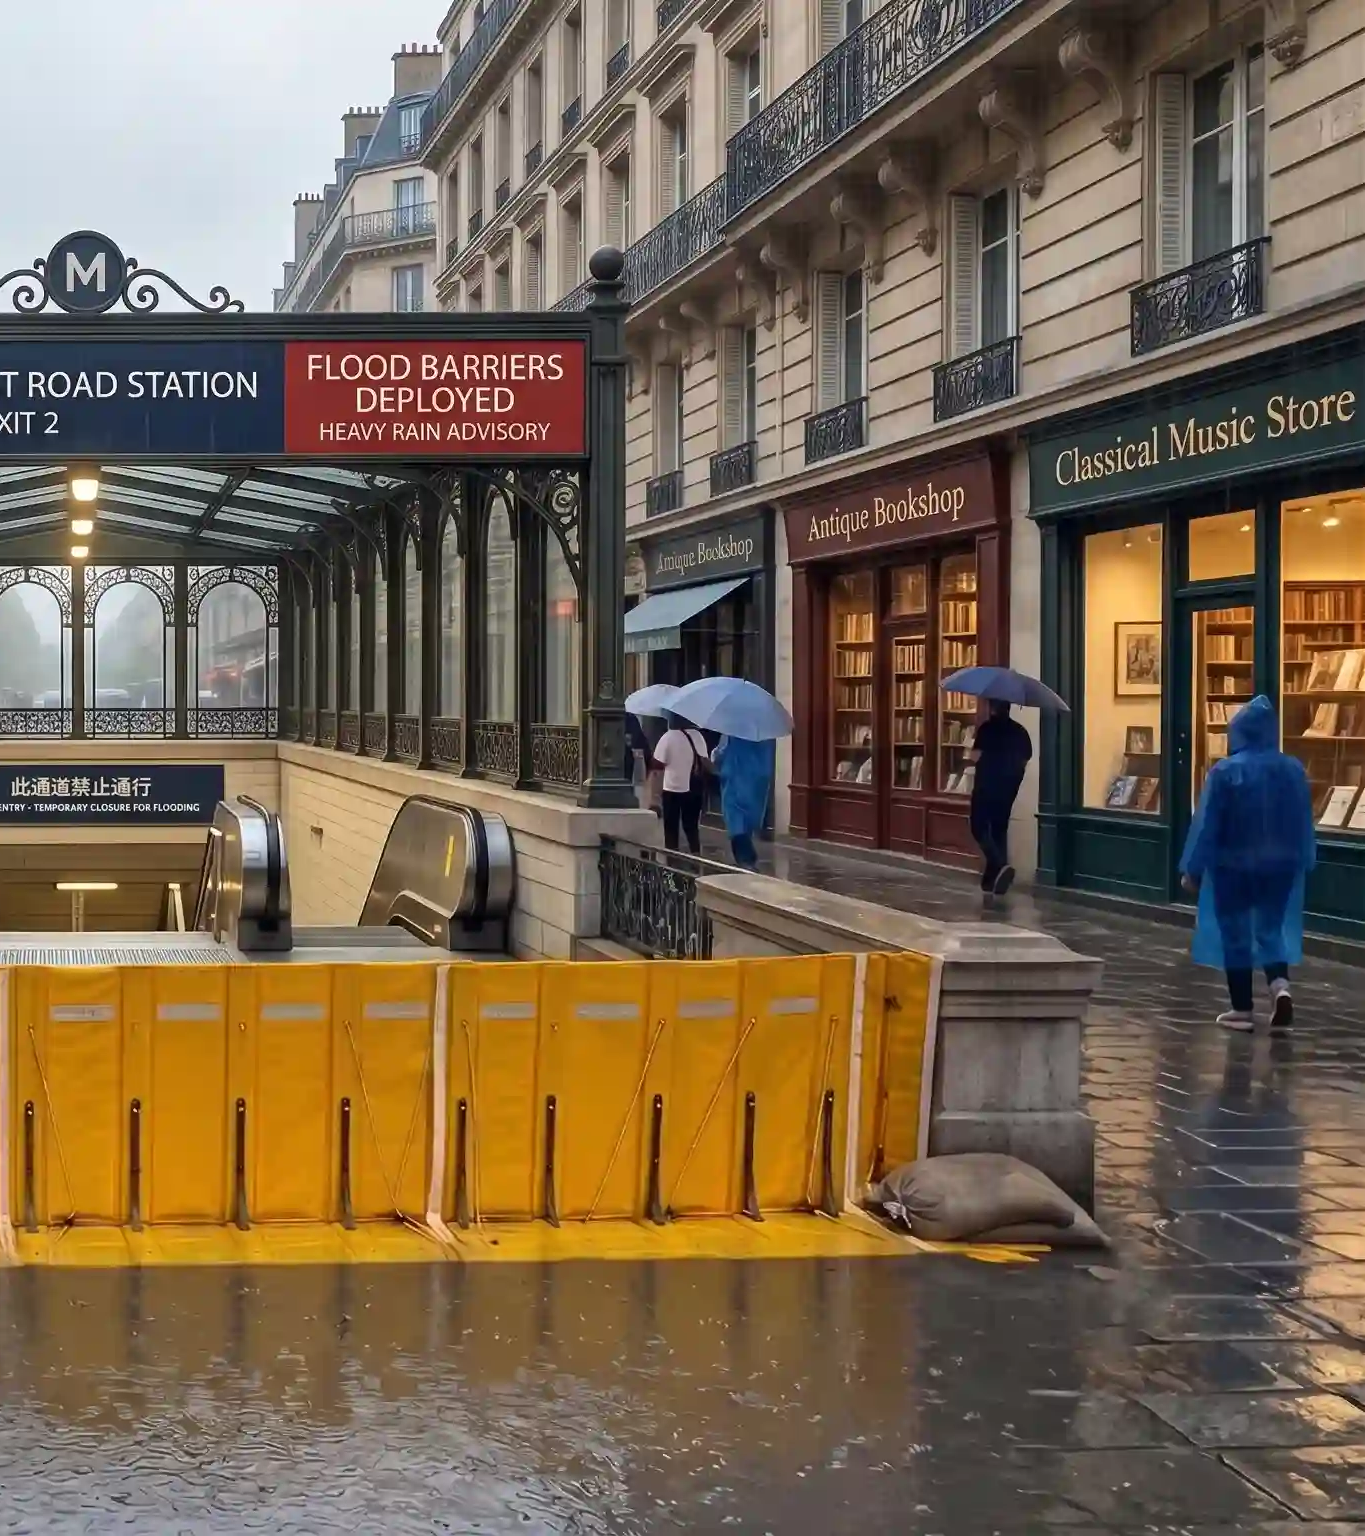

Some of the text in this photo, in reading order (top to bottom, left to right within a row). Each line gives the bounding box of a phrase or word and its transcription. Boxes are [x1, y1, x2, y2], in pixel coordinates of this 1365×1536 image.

[66, 252, 106, 293] M
[307, 353, 565, 381] FLOOD BARRIERS
[28, 371, 118, 399] ROAD
[127, 370, 258, 399] STATION
[356, 386, 516, 413] DEPLOYED
[43, 411, 60, 434] 2
[319, 422, 551, 441] HEAVY RAIN ADVISORY
[1055, 390, 1356, 486] Classical Music Store
[807, 482, 966, 544] Antique Bookshop
[10, 775, 152, 798] 此通道禁止通行
[33, 803, 89, 812] TEMPORARY
[90, 803, 132, 812] CLOSURE
[133, 803, 152, 812] FOR
[153, 803, 200, 812] FLOODING
